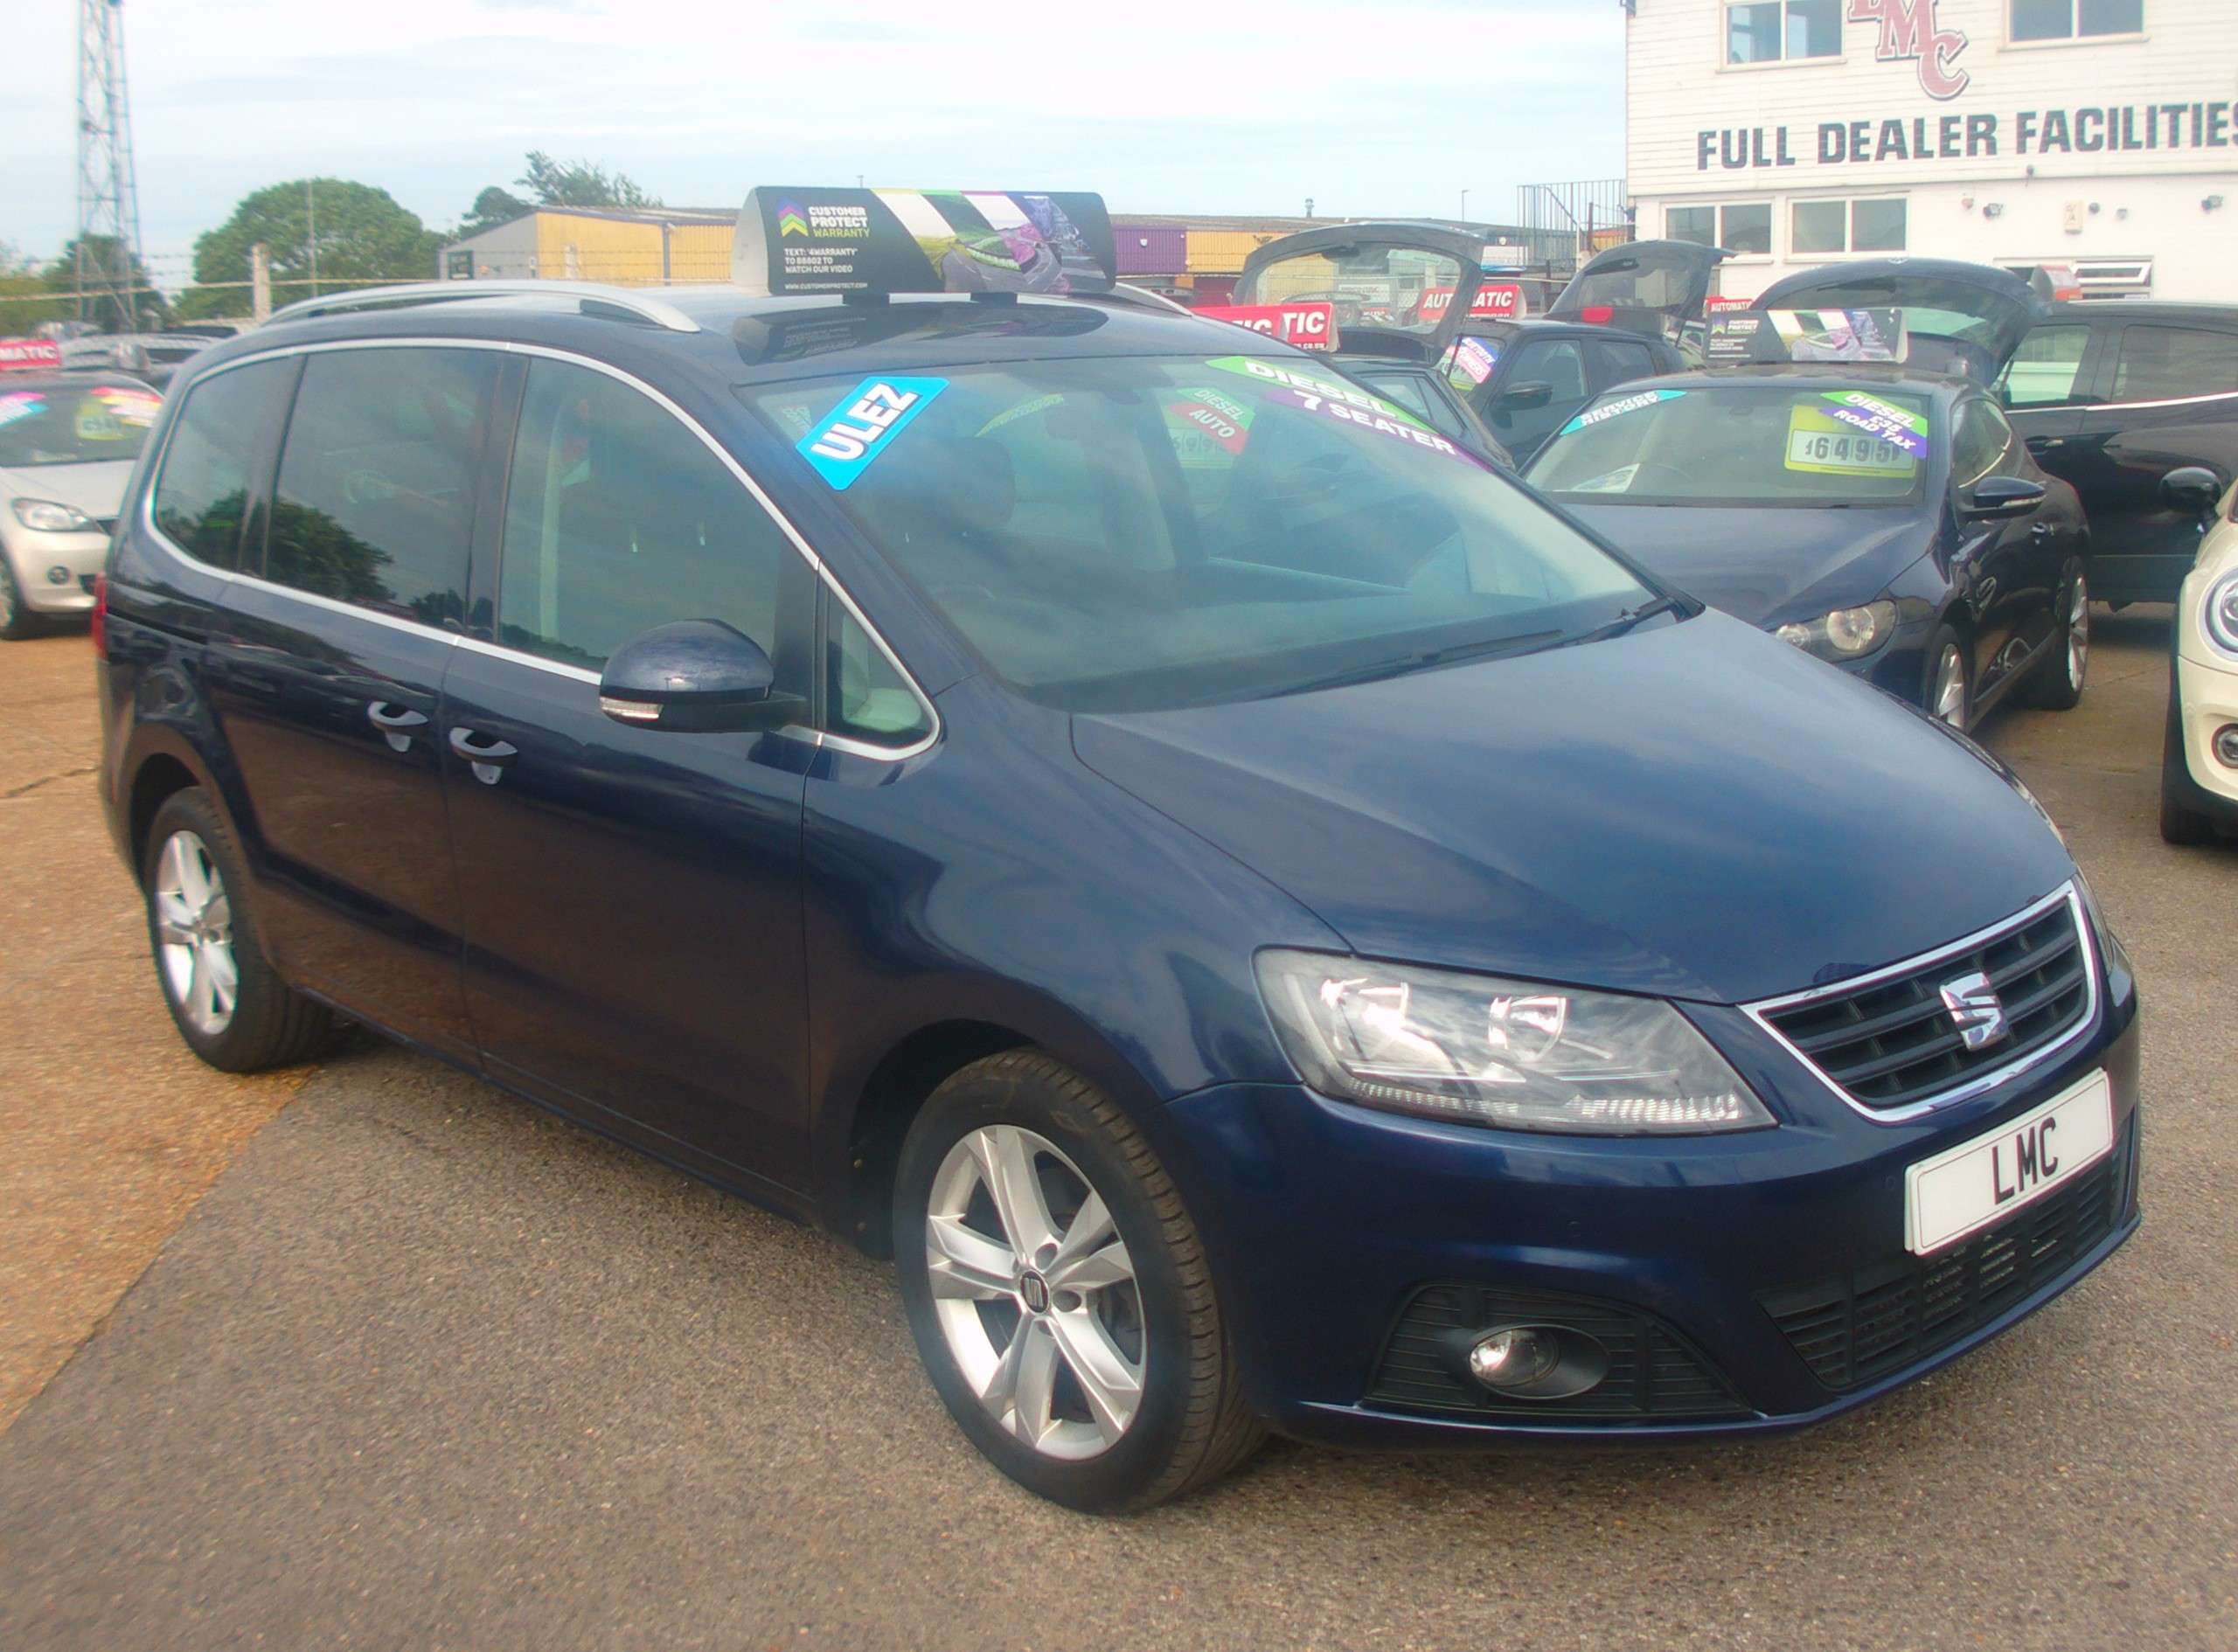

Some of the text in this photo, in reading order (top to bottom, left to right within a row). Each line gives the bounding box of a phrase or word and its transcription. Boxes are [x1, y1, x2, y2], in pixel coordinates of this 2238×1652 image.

[1698, 101, 2238, 170] FULL DEALER FACILITIE
[809, 206, 866, 216] CUSTOMER
[810, 217, 868, 227] PROTECT
[813, 228, 871, 238] WARRANTY
[1711, 302, 1752, 311] AUTOMATI
[1193, 390, 1245, 420] DIESEL
[1245, 360, 1397, 418] DIESEL
[811, 382, 920, 461] ULEZ
[1188, 409, 1236, 438] AUTO
[1293, 389, 1456, 455] 7 SEATER
[1845, 393, 1916, 427] DIESEL
[1833, 409, 1916, 450] ROAD TAX
[1992, 1116, 2059, 1206] LMC
